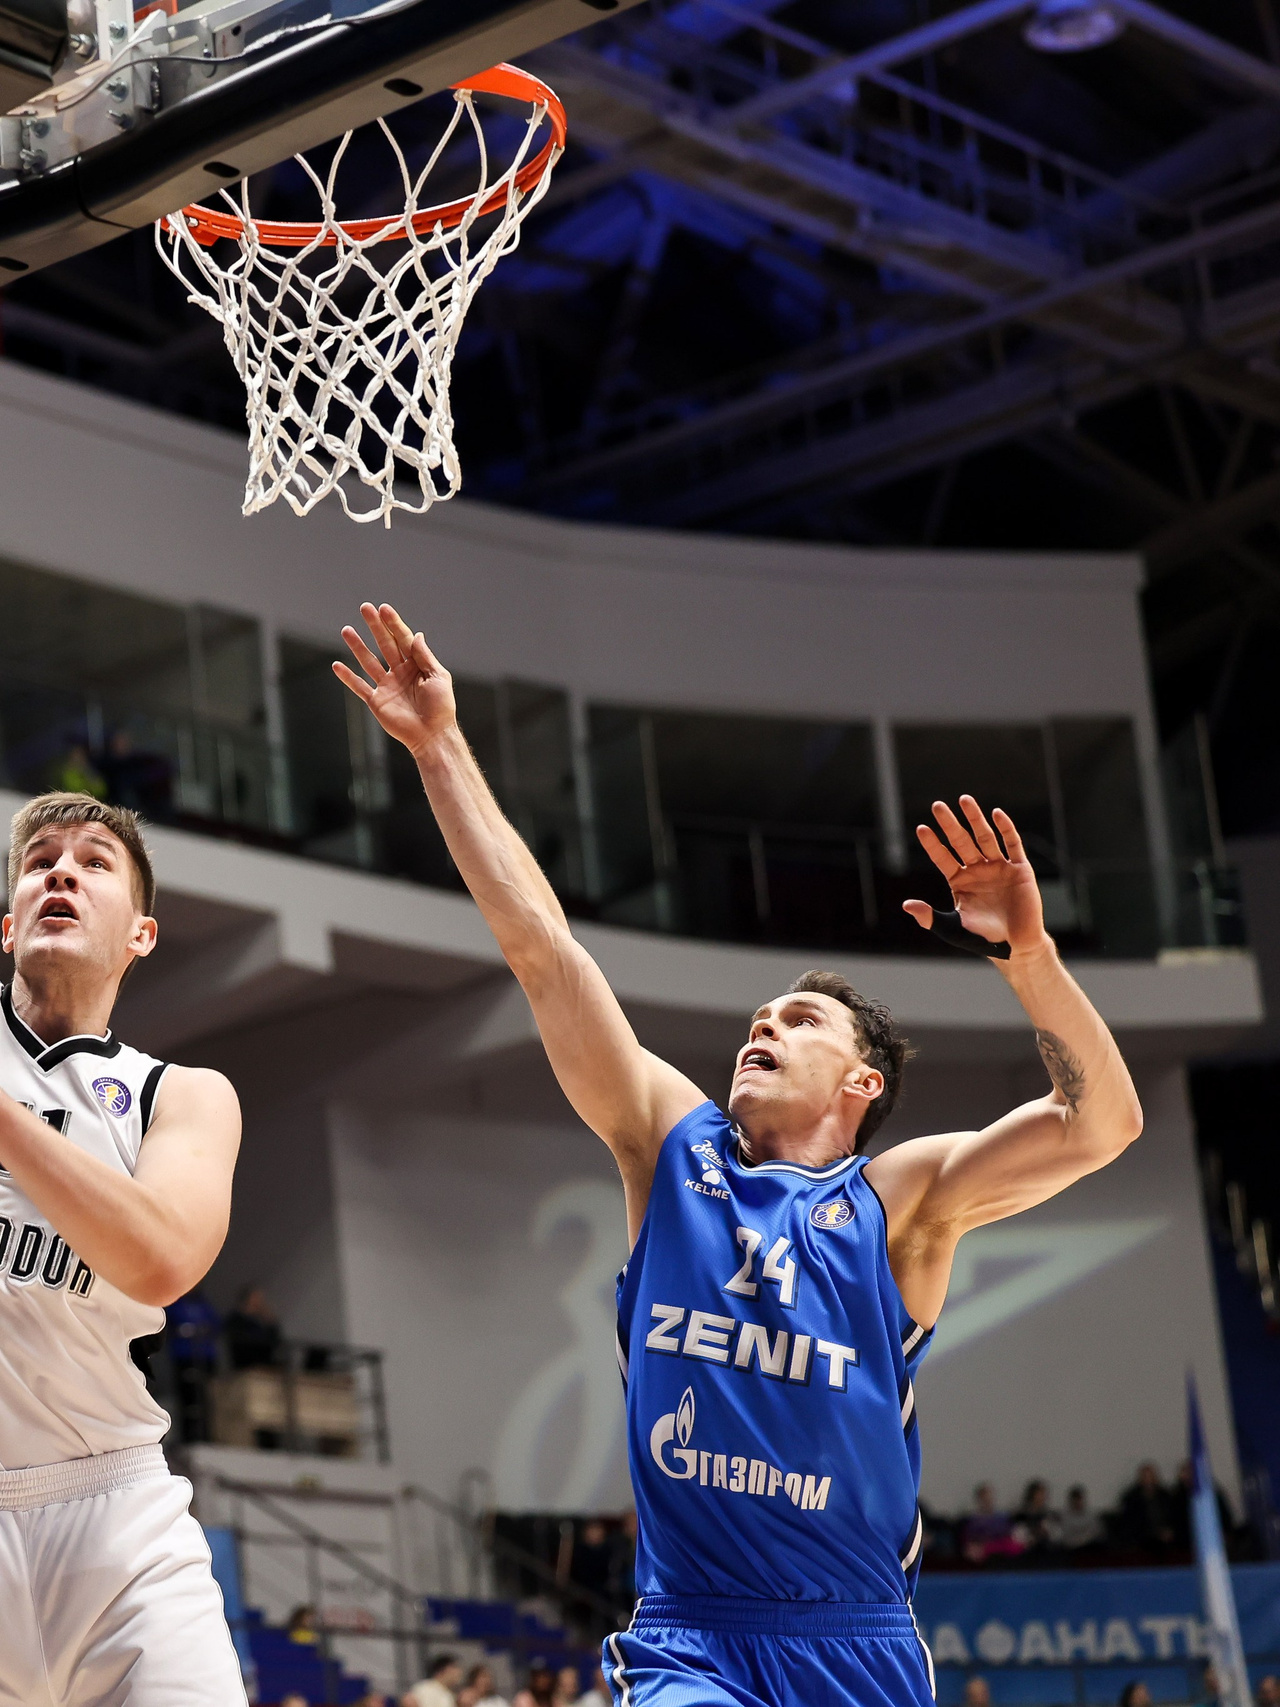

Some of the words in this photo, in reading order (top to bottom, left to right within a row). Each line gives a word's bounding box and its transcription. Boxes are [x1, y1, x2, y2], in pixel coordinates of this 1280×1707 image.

[683, 1178, 731, 1200] KELME
[723, 1226, 797, 1307] 24
[645, 1303, 859, 1390] ZENIT
